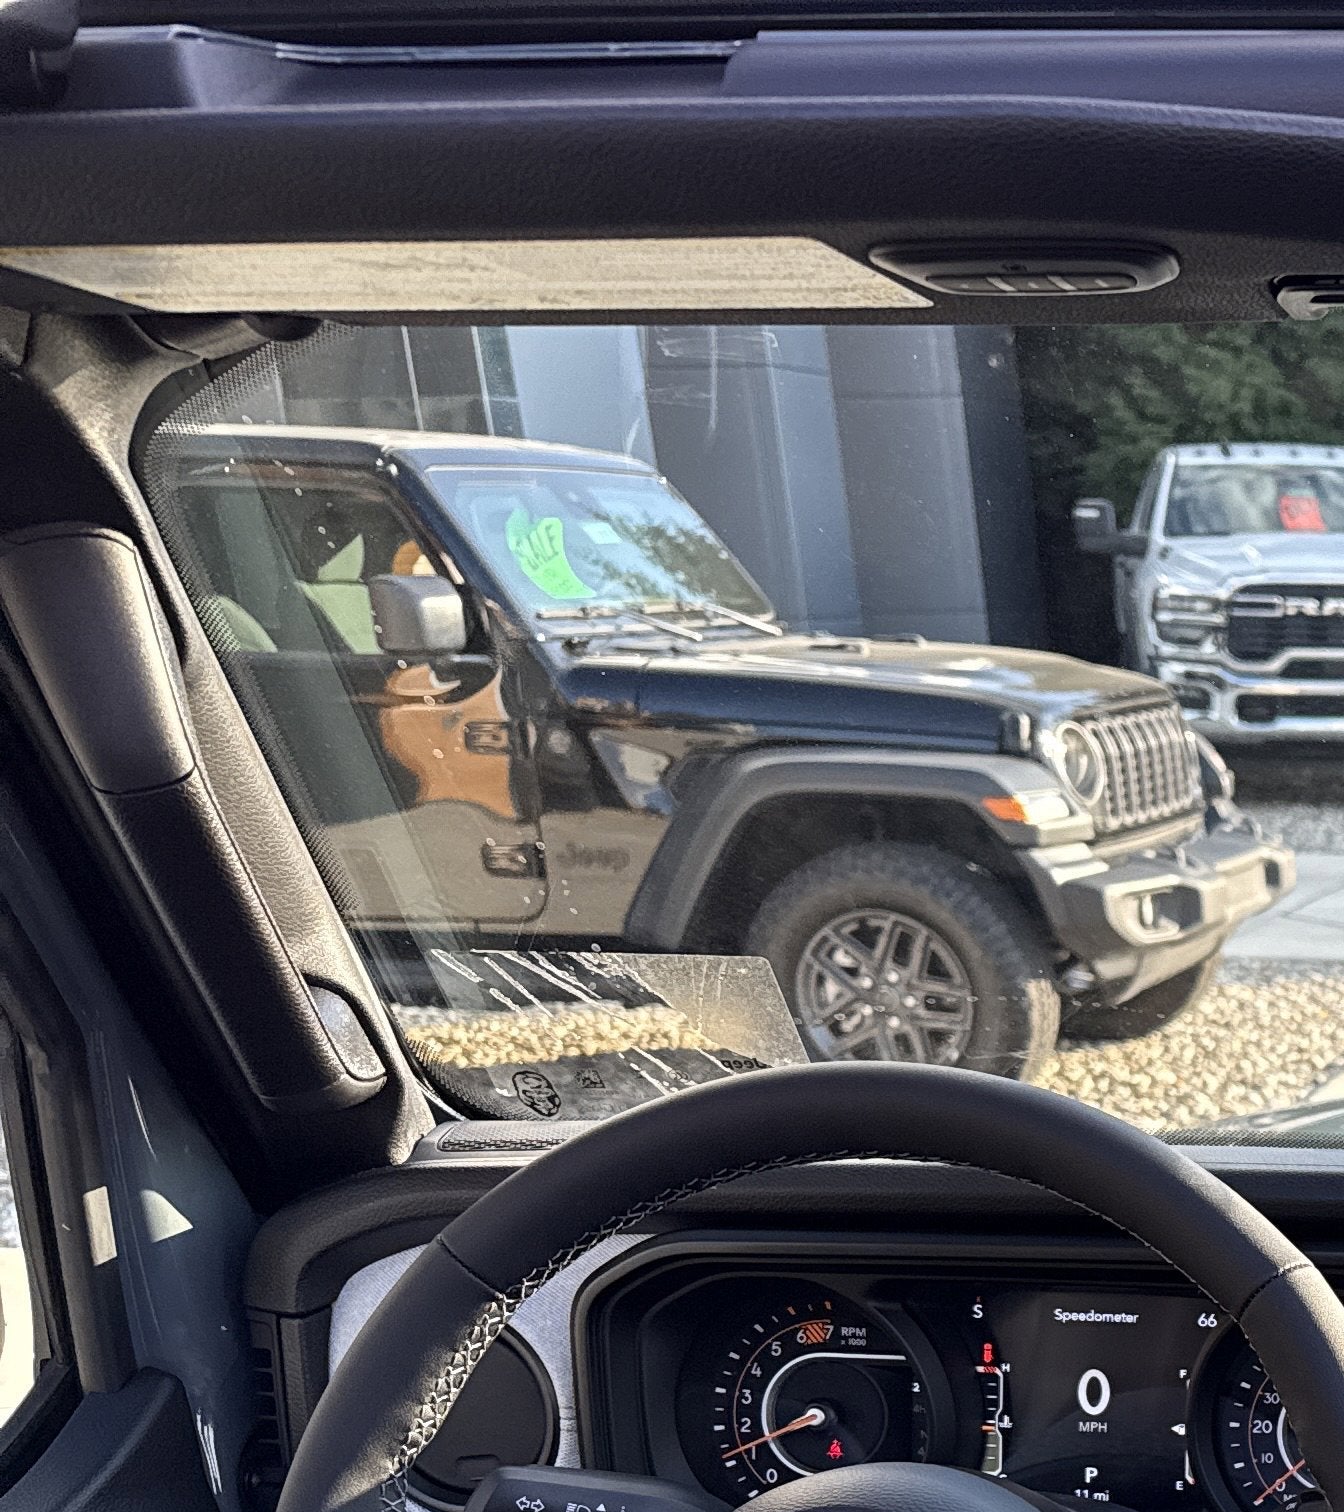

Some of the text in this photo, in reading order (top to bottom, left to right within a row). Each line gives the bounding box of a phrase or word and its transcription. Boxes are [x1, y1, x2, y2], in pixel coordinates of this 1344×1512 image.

[973, 1304, 983, 1319] S
[1054, 1307, 1139, 1323] Speedometer
[1197, 1313, 1217, 1328] 66
[796, 1329, 807, 1344] 6
[825, 1325, 834, 1340] 7
[841, 1326, 867, 1338] RPM
[772, 1342, 781, 1356] 5
[751, 1363, 762, 1377] 4
[1001, 1363, 1010, 1373] H
[1179, 1369, 1187, 1379] F
[741, 1389, 752, 1404] 3
[1077, 1369, 1111, 1416] 0
[1263, 1392, 1280, 1404] 30
[741, 1418, 752, 1432] 2
[1078, 1421, 1108, 1433] MPH
[1252, 1419, 1273, 1434] 20
[1261, 1451, 1274, 1464] 10
[766, 1469, 778, 1483] 0
[1084, 1466, 1098, 1483] P
[1175, 1480, 1184, 1491] E
[1093, 1489, 1109, 1501] mi
